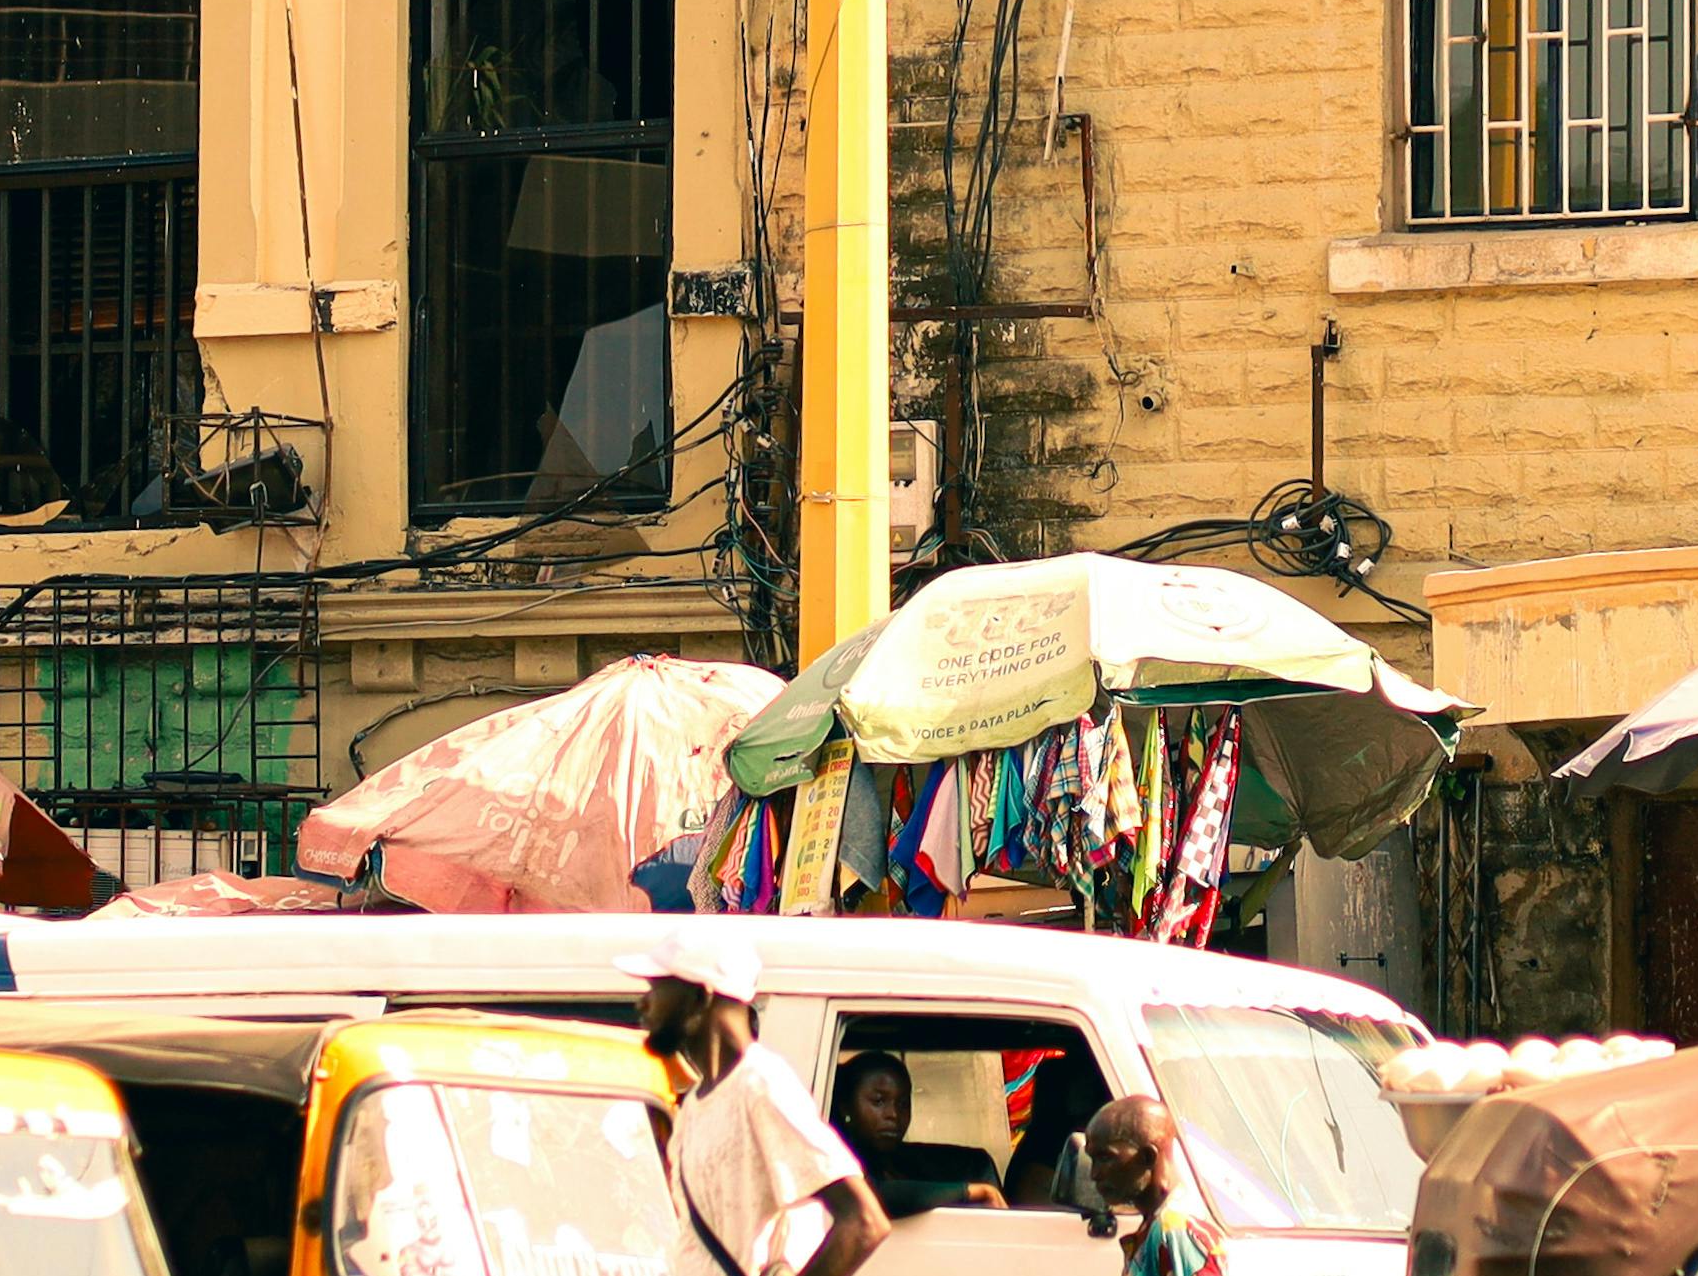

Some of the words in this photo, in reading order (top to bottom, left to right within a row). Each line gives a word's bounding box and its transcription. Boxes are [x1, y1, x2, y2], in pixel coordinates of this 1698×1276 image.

[921, 657, 1031, 689] EVERYTHING
[1035, 644, 1067, 666] GLO
[937, 654, 973, 671] ONE
[978, 643, 1026, 665] CODE
[1029, 631, 1062, 652] FOR
[912, 726, 954, 740] VOICE
[957, 725, 967, 735] &
[969, 714, 1005, 731] DATA
[476, 800, 533, 839] for
[508, 828, 580, 886] it!
